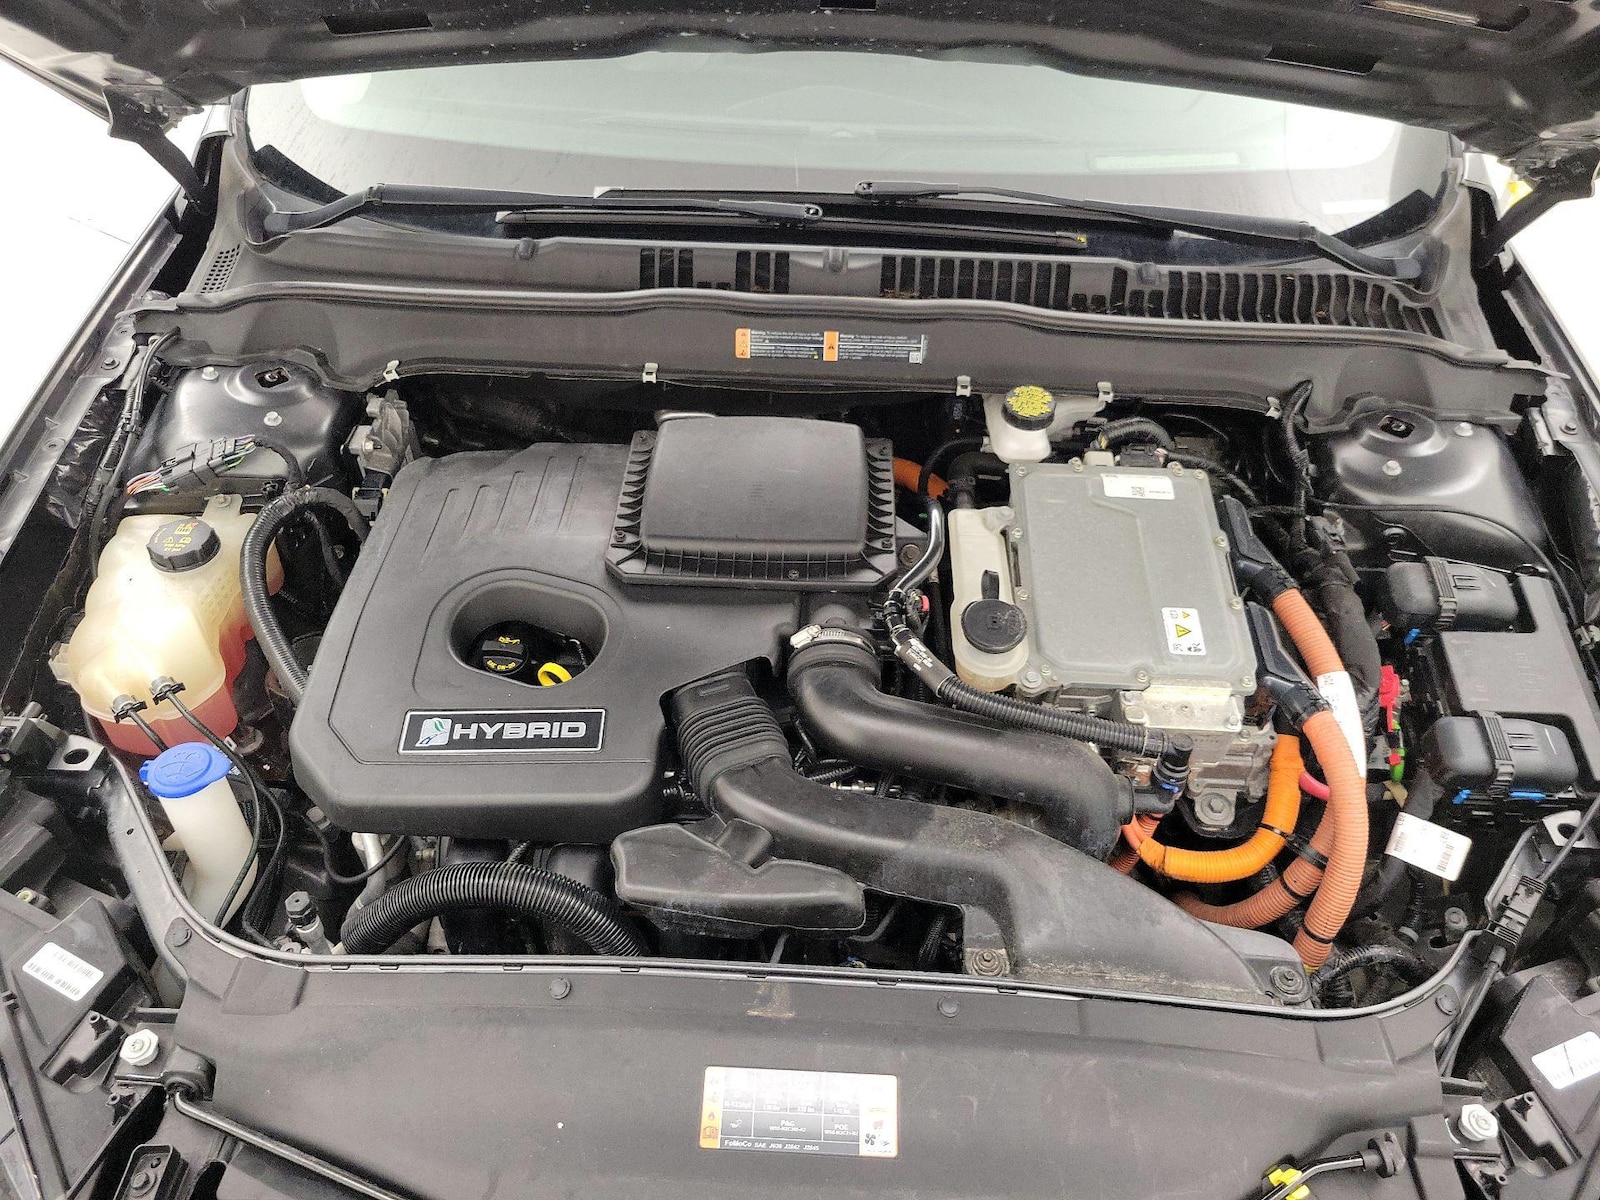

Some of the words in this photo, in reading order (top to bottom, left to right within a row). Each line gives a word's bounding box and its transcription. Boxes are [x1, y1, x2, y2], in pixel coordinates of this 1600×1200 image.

[452, 721, 587, 740] HYBRID
[780, 1119, 795, 1127] PAG
[724, 1139, 752, 1148] FoMoCo
[754, 1141, 767, 1149] SAE
